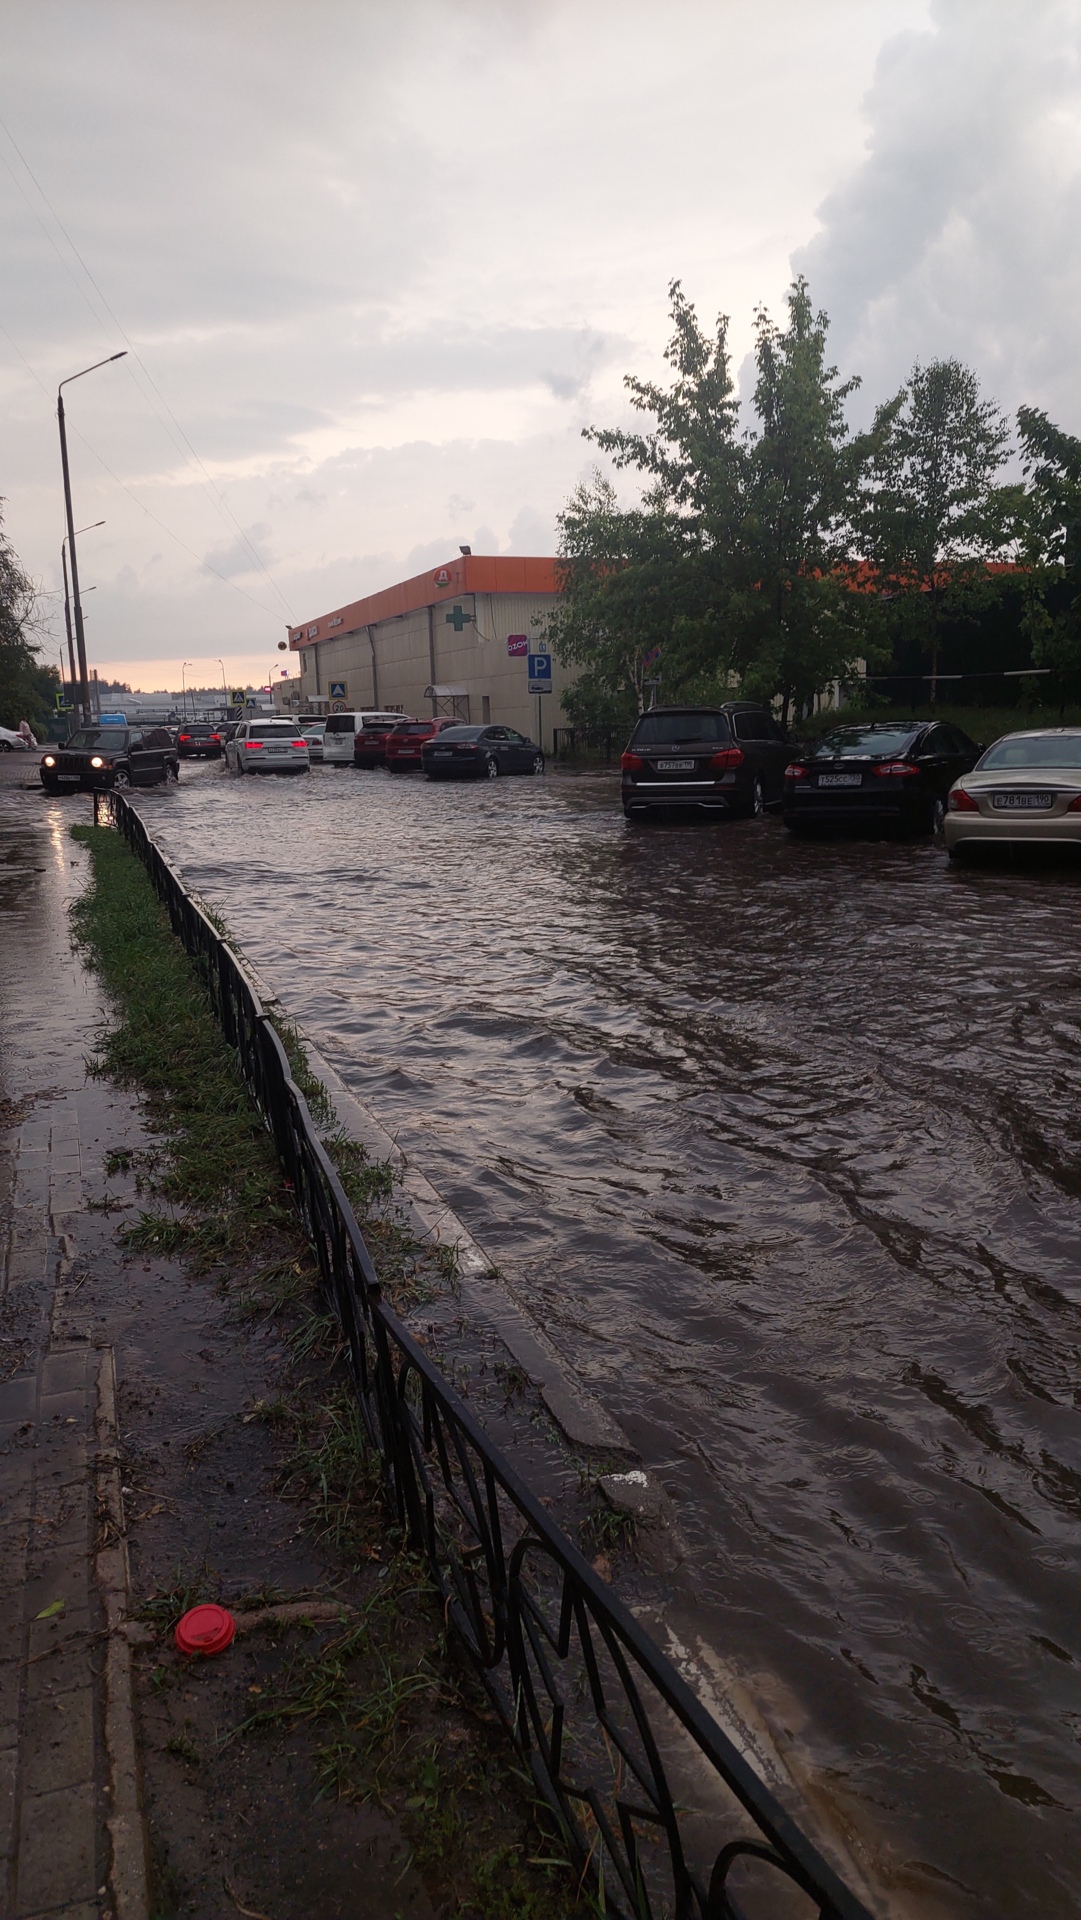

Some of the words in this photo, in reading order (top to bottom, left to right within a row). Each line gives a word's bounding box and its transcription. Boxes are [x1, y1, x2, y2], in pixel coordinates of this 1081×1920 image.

[438, 570, 449, 581] Д
[534, 657, 547, 677] P
[335, 704, 344, 712] 20
